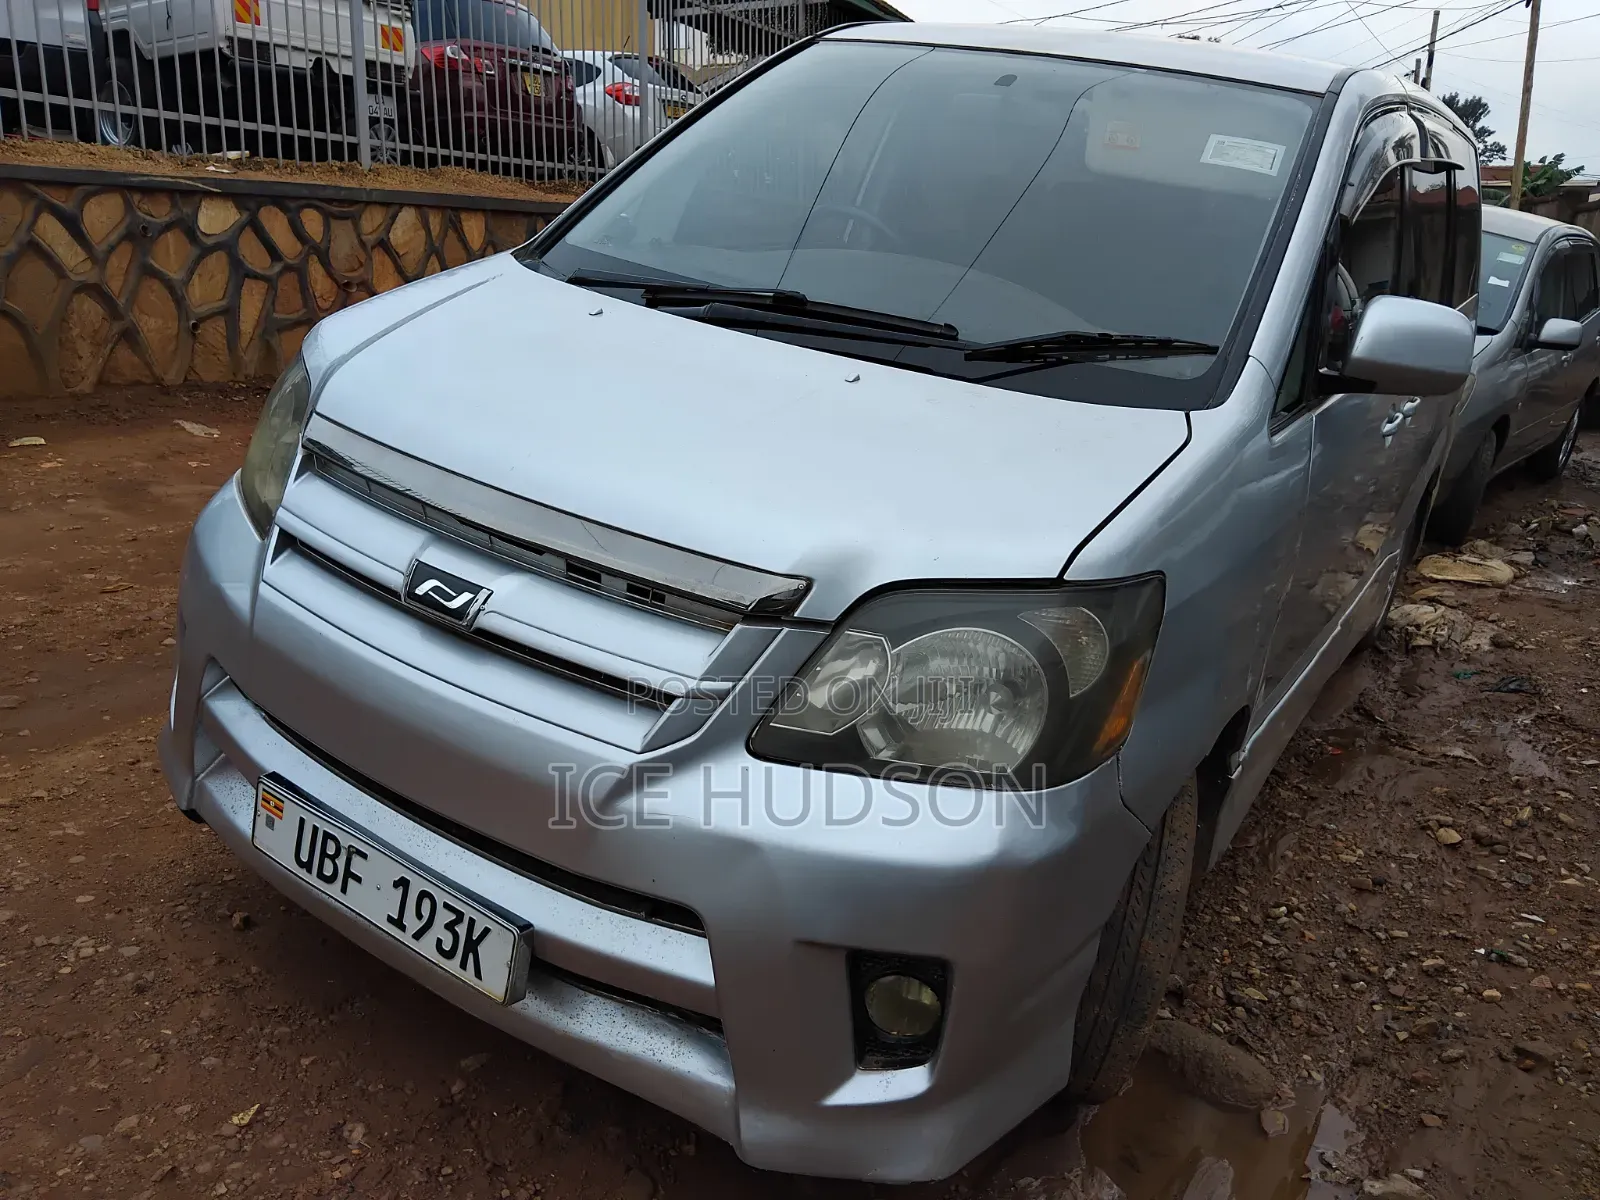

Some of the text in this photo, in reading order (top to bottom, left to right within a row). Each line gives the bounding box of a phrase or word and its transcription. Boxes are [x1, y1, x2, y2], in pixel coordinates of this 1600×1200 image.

[369, 105, 392, 117] 04AU
[294, 816, 491, 981] UBF 193K
